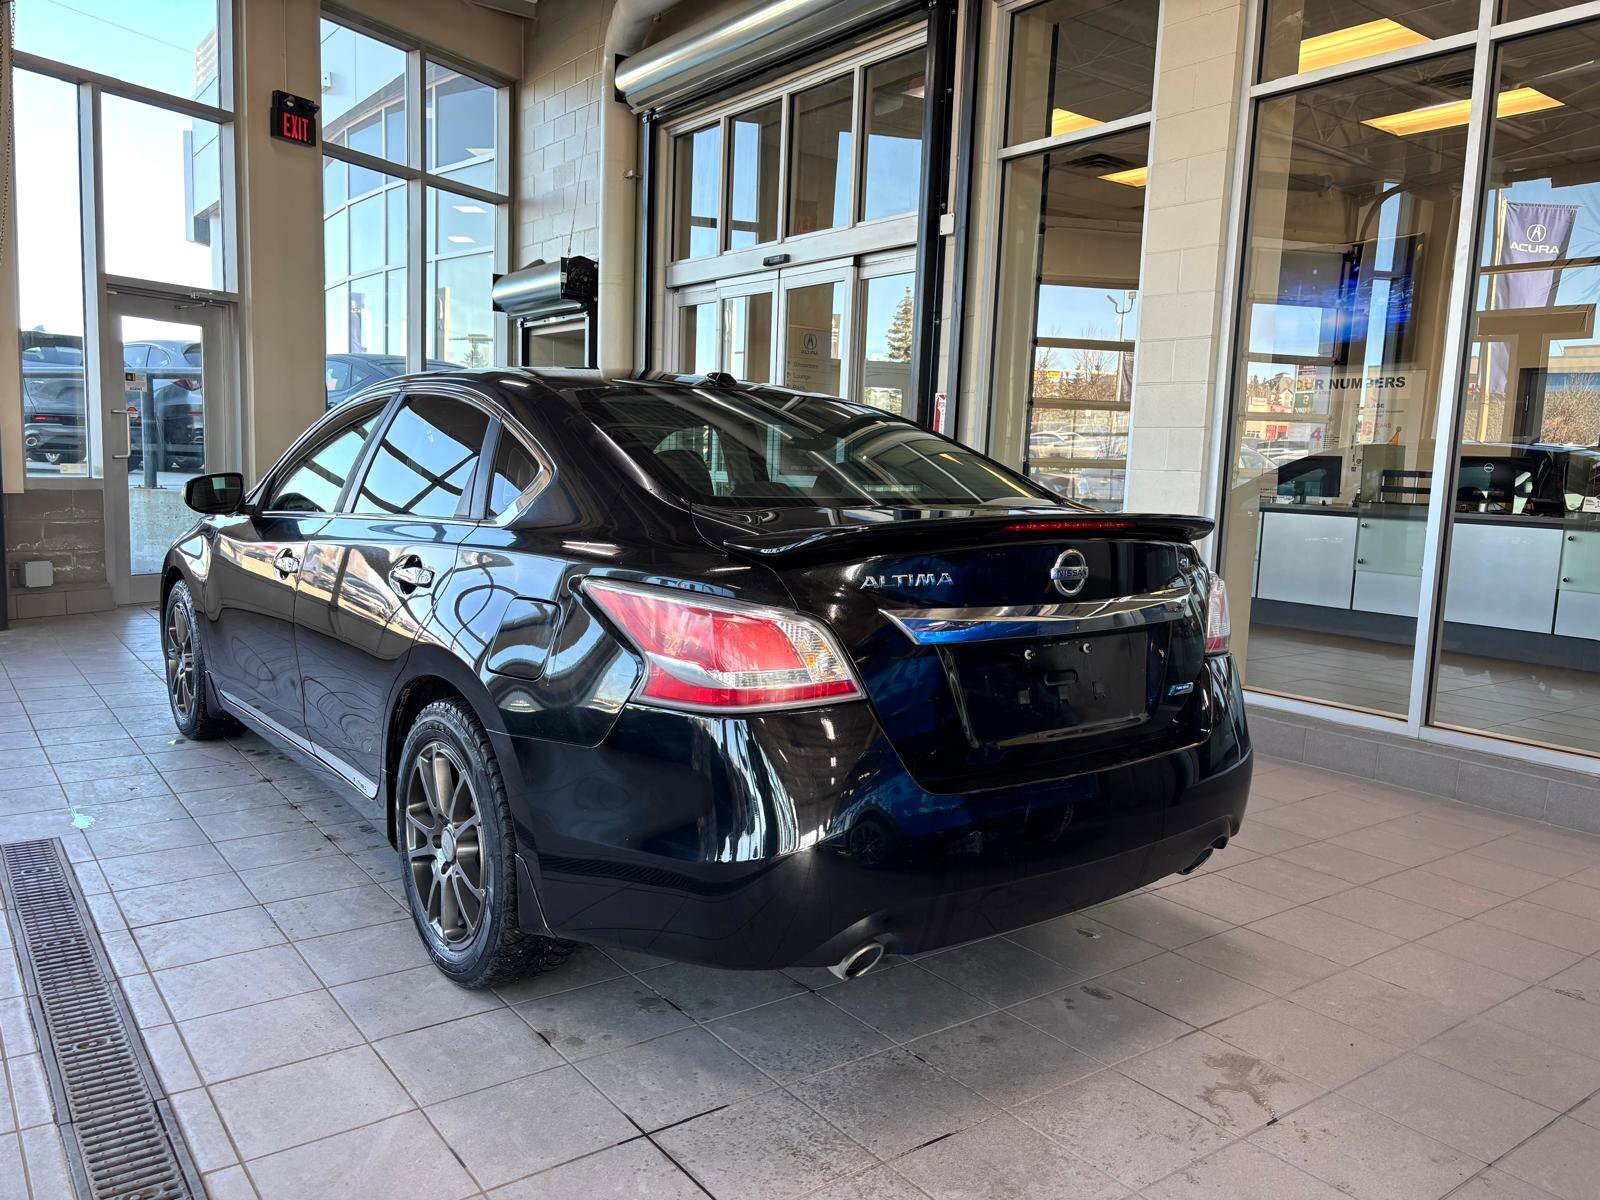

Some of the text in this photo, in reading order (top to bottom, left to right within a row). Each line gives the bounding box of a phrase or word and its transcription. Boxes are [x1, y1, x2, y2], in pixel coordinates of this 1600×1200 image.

[283, 111, 309, 142] EXIT
[1510, 242, 1560, 254] ACURA
[860, 573, 954, 589] ALTIMA
[1057, 570, 1087, 578] NISSAN
